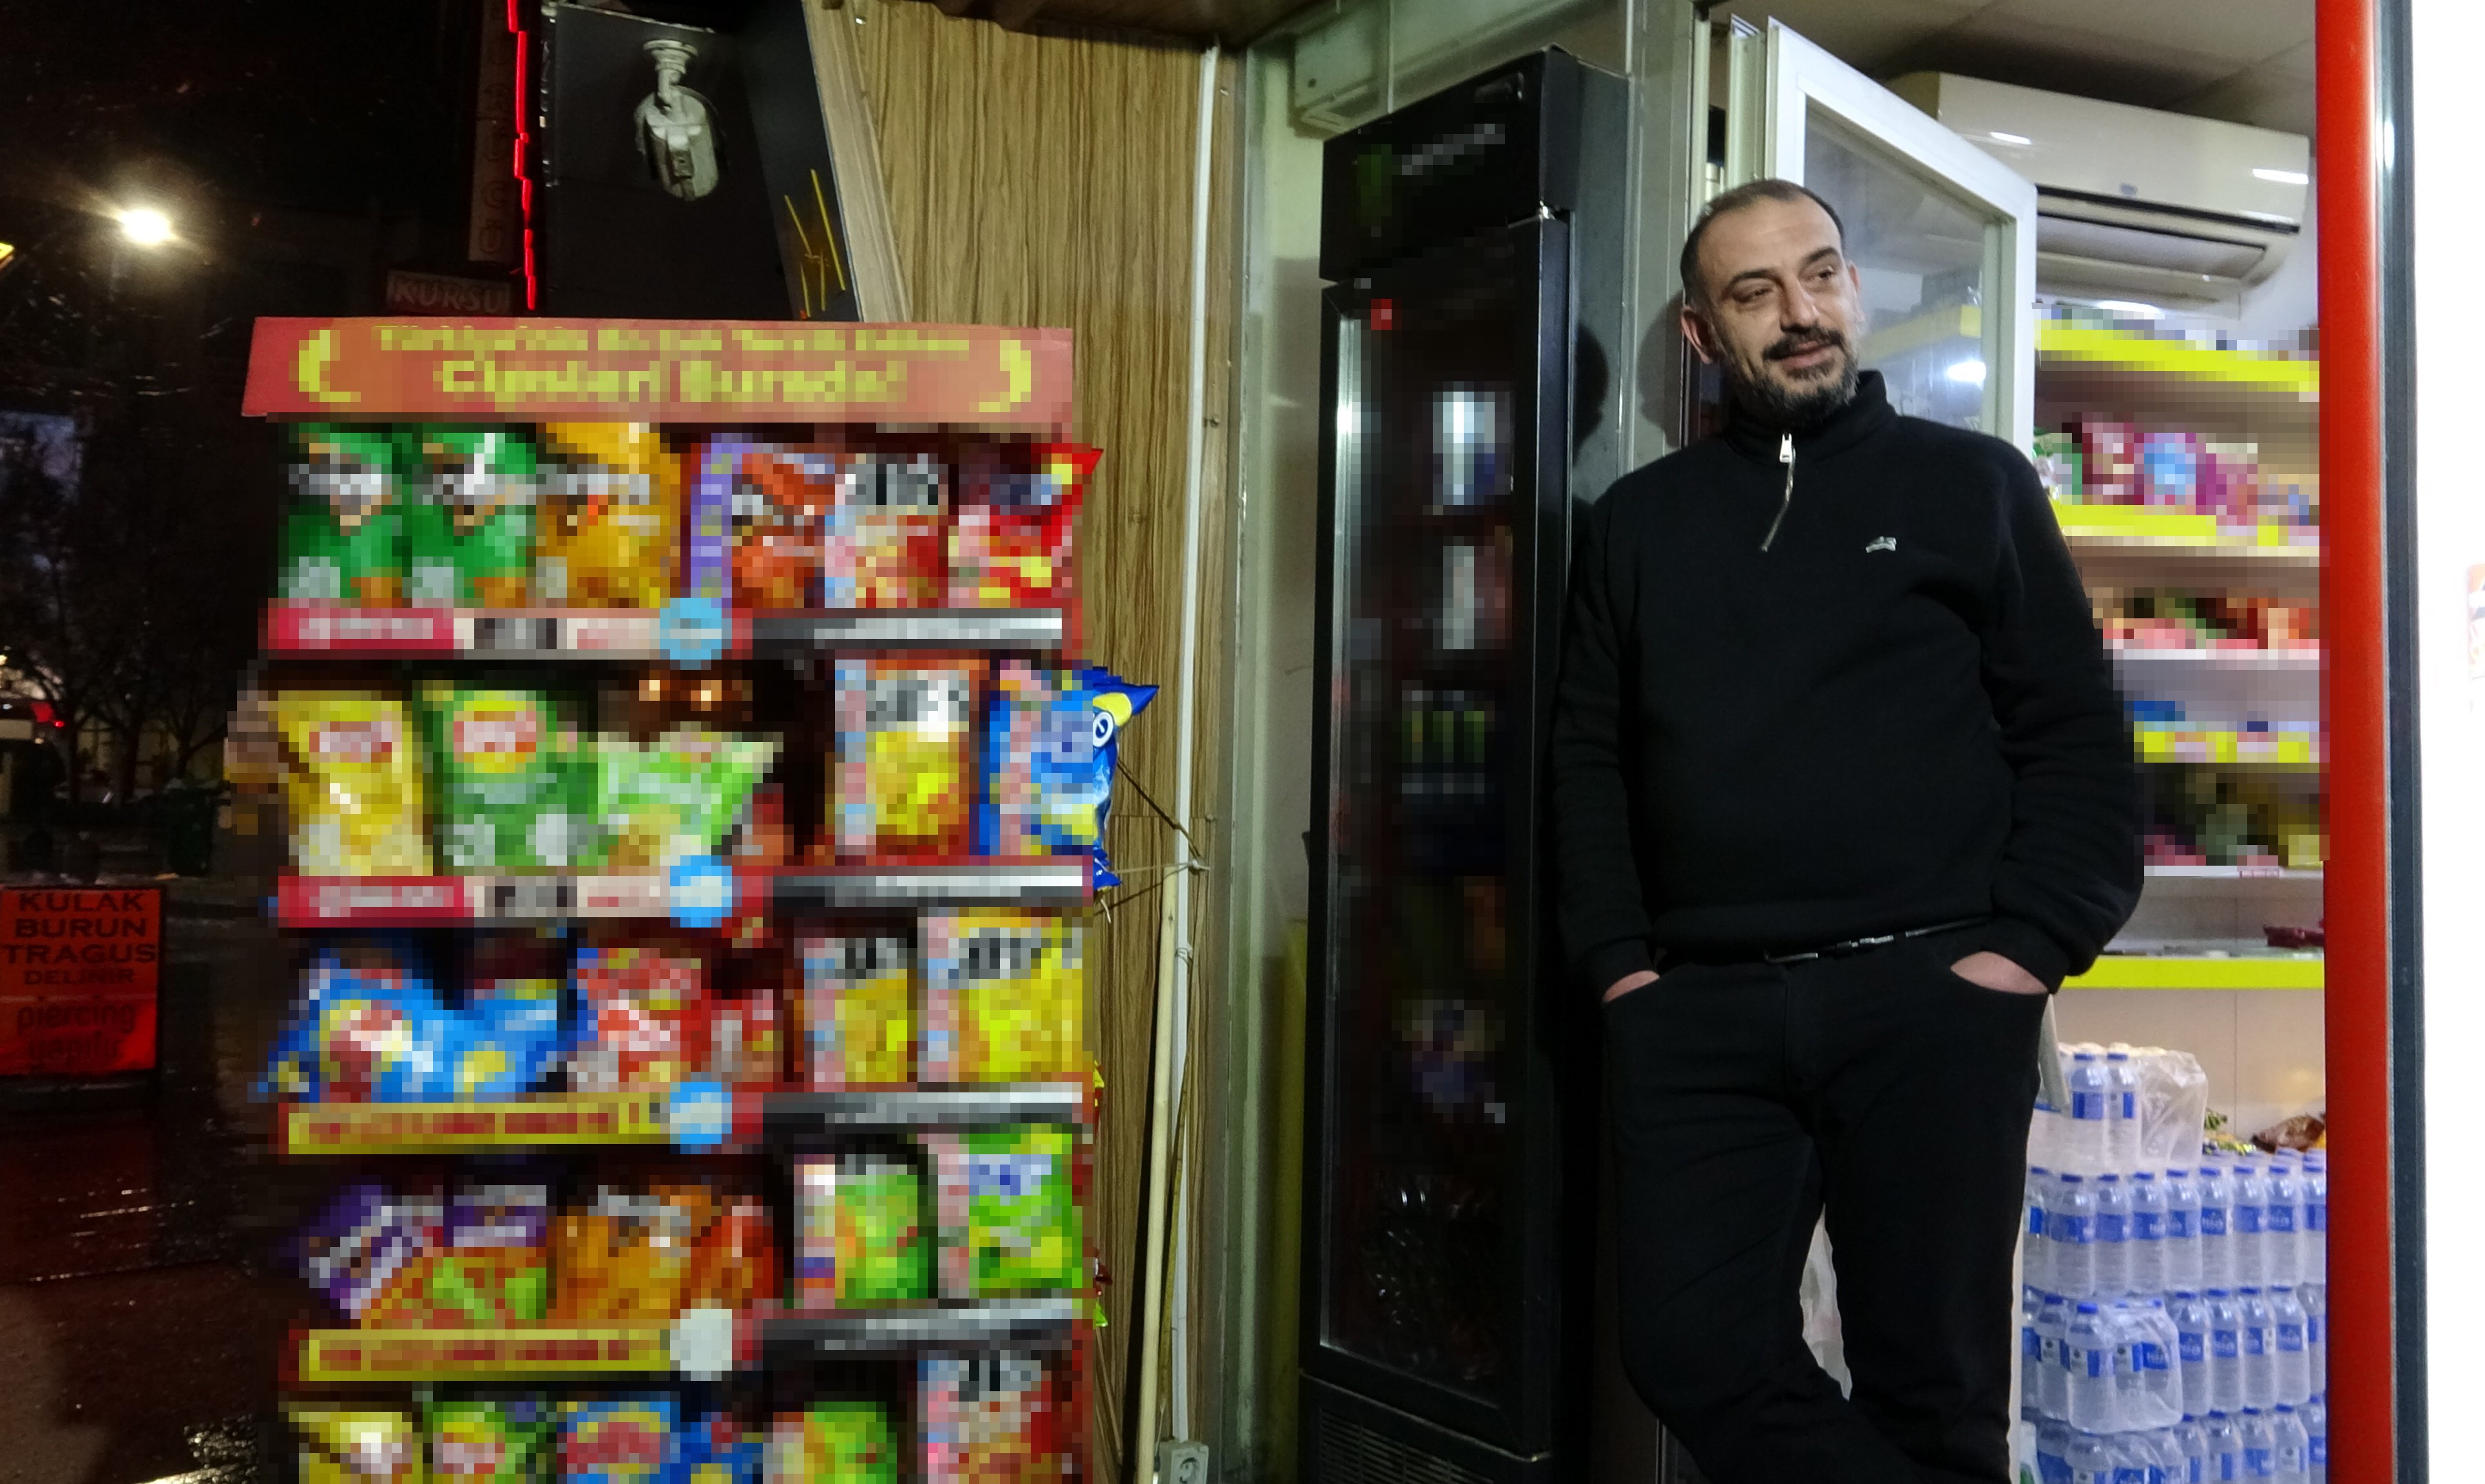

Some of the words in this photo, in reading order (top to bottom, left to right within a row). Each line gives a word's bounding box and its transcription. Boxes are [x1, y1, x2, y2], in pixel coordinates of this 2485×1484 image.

[394, 279, 504, 313] KURSU
[19, 892, 144, 912] KULAK
[15, 918, 147, 938] BURUN
[3, 943, 157, 964] TRAGUS
[17, 995, 135, 1035] piercing
